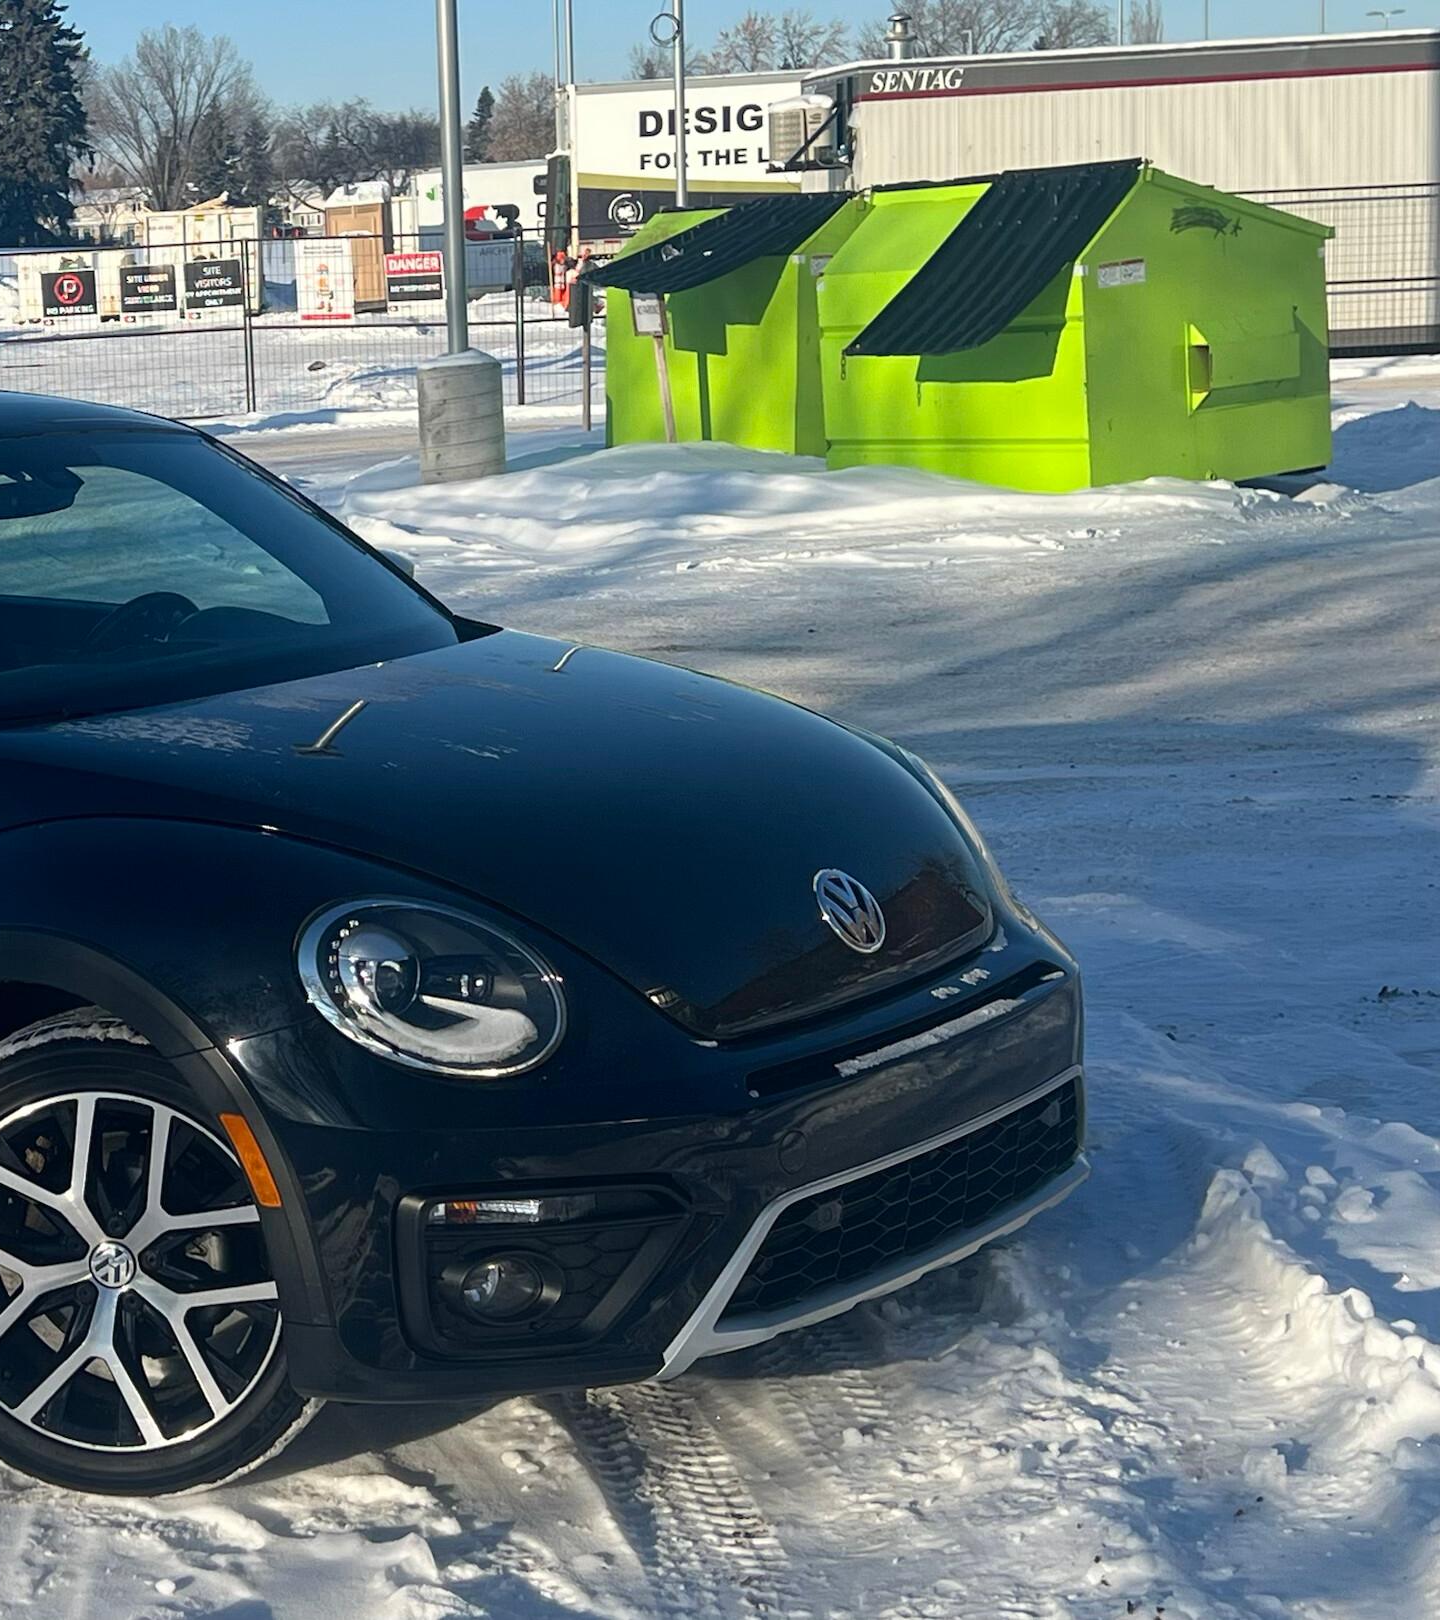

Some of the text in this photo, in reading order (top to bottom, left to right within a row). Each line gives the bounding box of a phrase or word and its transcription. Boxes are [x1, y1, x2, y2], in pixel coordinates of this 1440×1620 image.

[870, 68, 964, 93] SENTAG
[697, 148, 748, 166] THE
[202, 265, 222, 275] SITE
[388, 256, 440, 271] DANGER
[194, 277, 232, 288] VISITORS
[46, 304, 94, 315] NO PARKING
